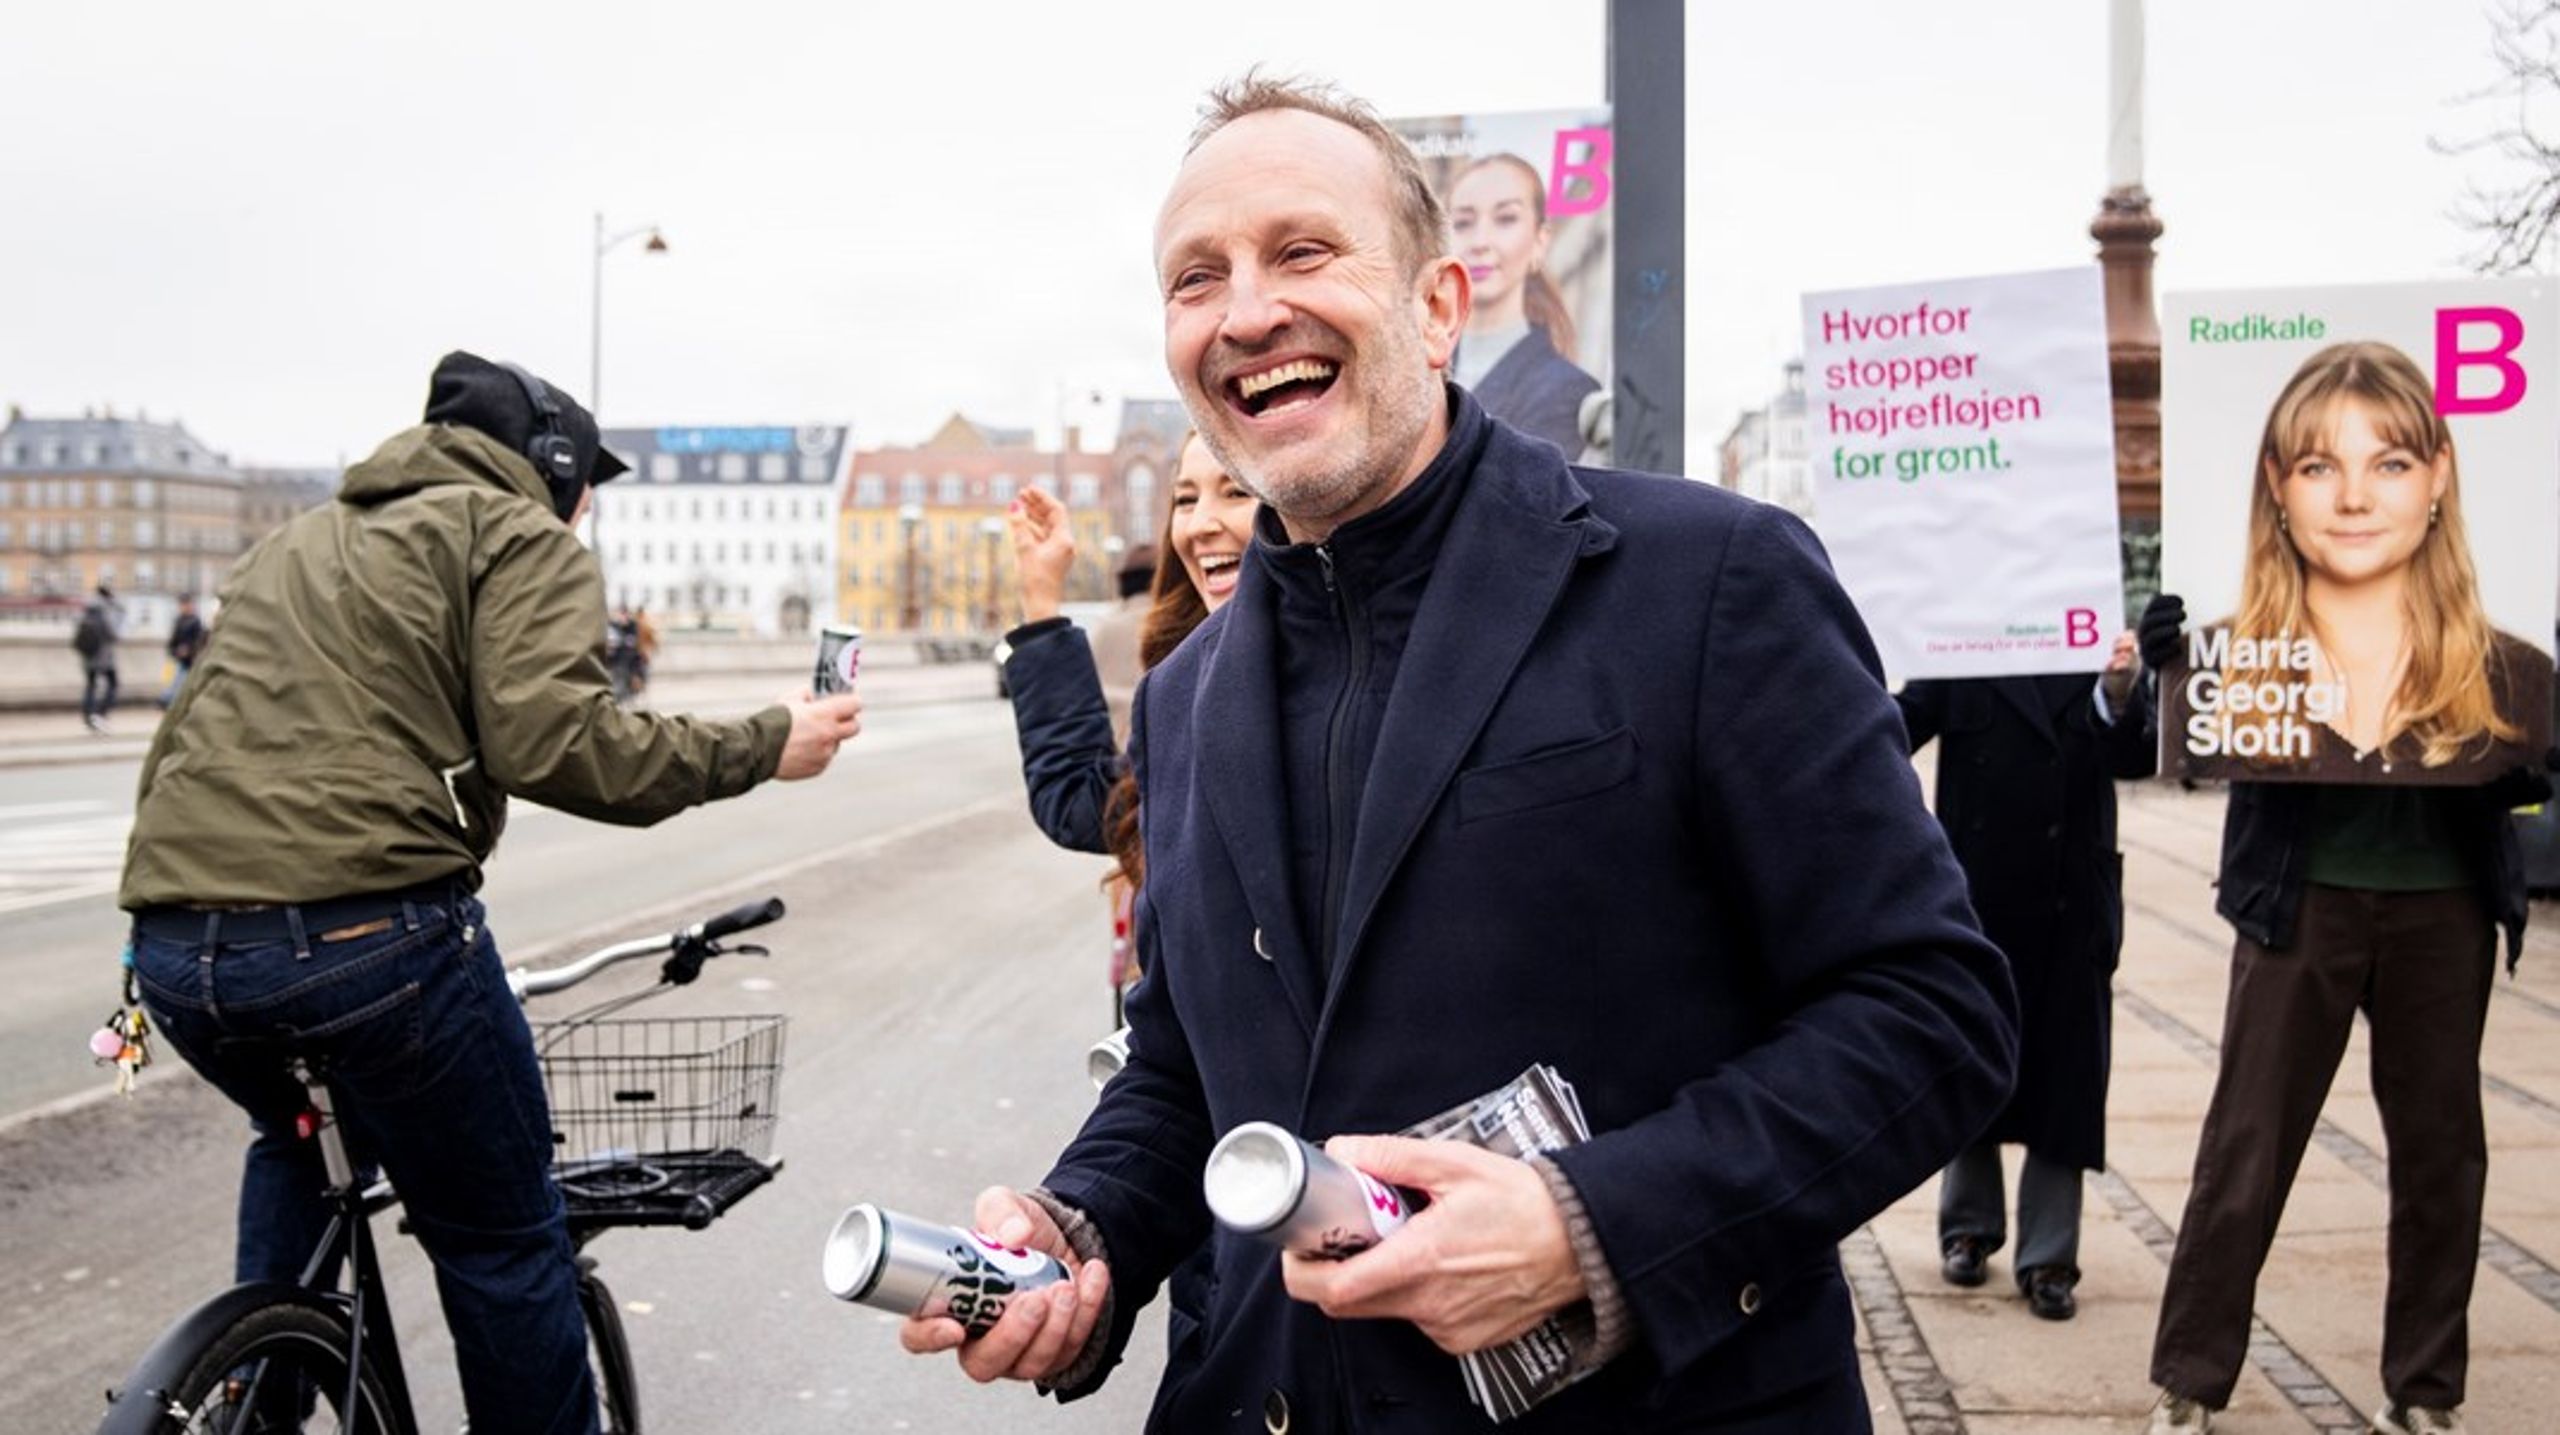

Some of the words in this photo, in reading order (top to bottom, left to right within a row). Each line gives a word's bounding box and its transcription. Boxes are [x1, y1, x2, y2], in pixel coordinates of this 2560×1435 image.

[1545, 125, 1611, 217] B
[1823, 302, 1971, 344] Hvorfor
[2190, 313, 2326, 343] Radikale
[1826, 353, 1978, 391] stopper
[2435, 306, 2527, 417] B
[1829, 389, 2042, 437] højrefløjen
[1834, 447, 1886, 480] for
[1896, 438, 2012, 483] grønt.
[2066, 607, 2099, 648] B
[2188, 628, 2318, 671] Maria
[2187, 671, 2346, 722] Georgi
[2187, 713, 2311, 757] Sloth
